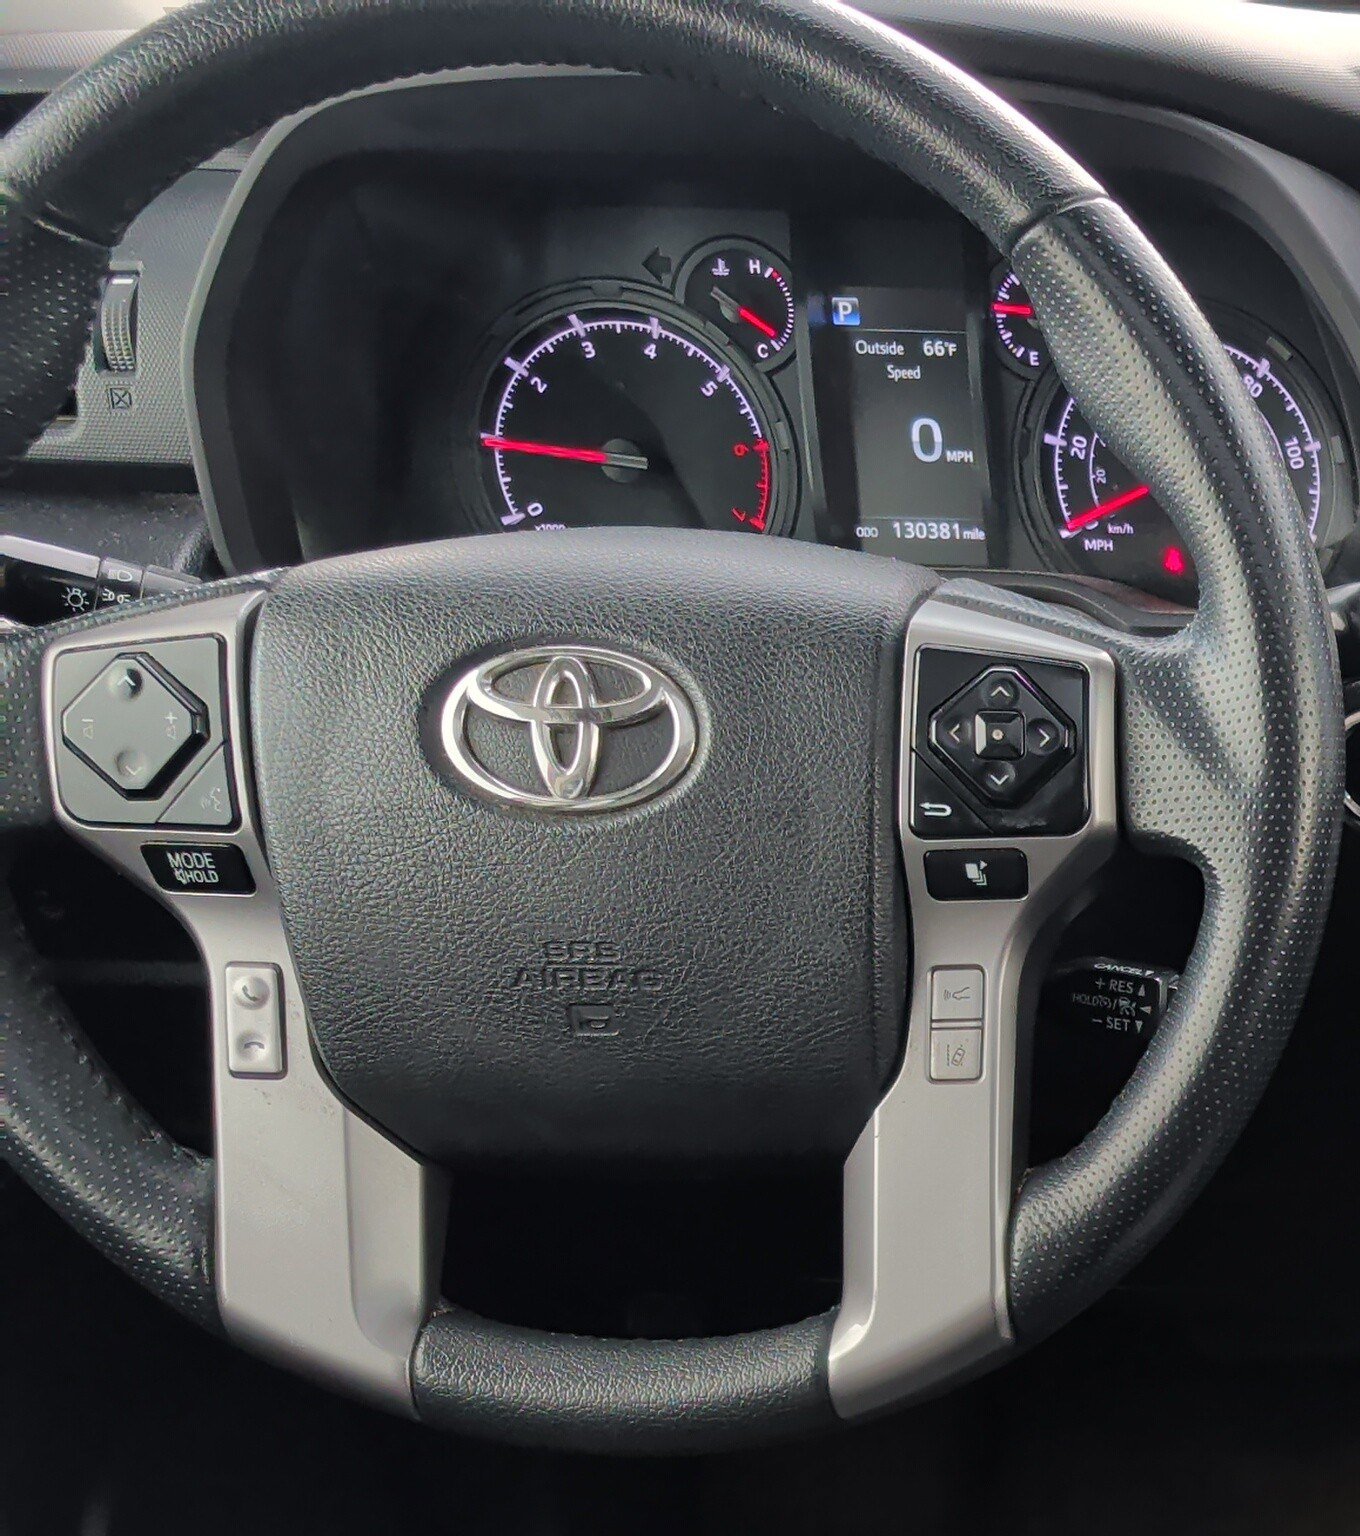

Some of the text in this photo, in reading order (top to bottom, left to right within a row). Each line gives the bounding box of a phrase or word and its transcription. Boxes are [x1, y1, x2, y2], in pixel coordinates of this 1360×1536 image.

[749, 260, 760, 274] H
[838, 301, 852, 322] P
[582, 341, 596, 359] 3
[643, 344, 657, 359] 4
[757, 344, 769, 358] C
[855, 339, 957, 357] Outside 66°F
[1029, 352, 1039, 366] E
[887, 364, 921, 382] Speed
[531, 377, 548, 393] 2
[701, 380, 717, 397] 5
[1244, 375, 1263, 398] 80
[911, 418, 974, 463] 0 MPH
[1070, 435, 1088, 461] 20
[733, 443, 749, 456] 6
[1285, 437, 1305, 470] 100
[1096, 469, 1106, 484] 20
[527, 502, 543, 517] 0
[856, 522, 986, 541] ODO 130381 mile
[1108, 523, 1134, 534] km/h
[1084, 539, 1113, 552] MPH
[166, 852, 215, 869] MODE
[187, 871, 219, 883] HOLD
[1110, 979, 1133, 994] RES
[1106, 1017, 1131, 1031] SET
